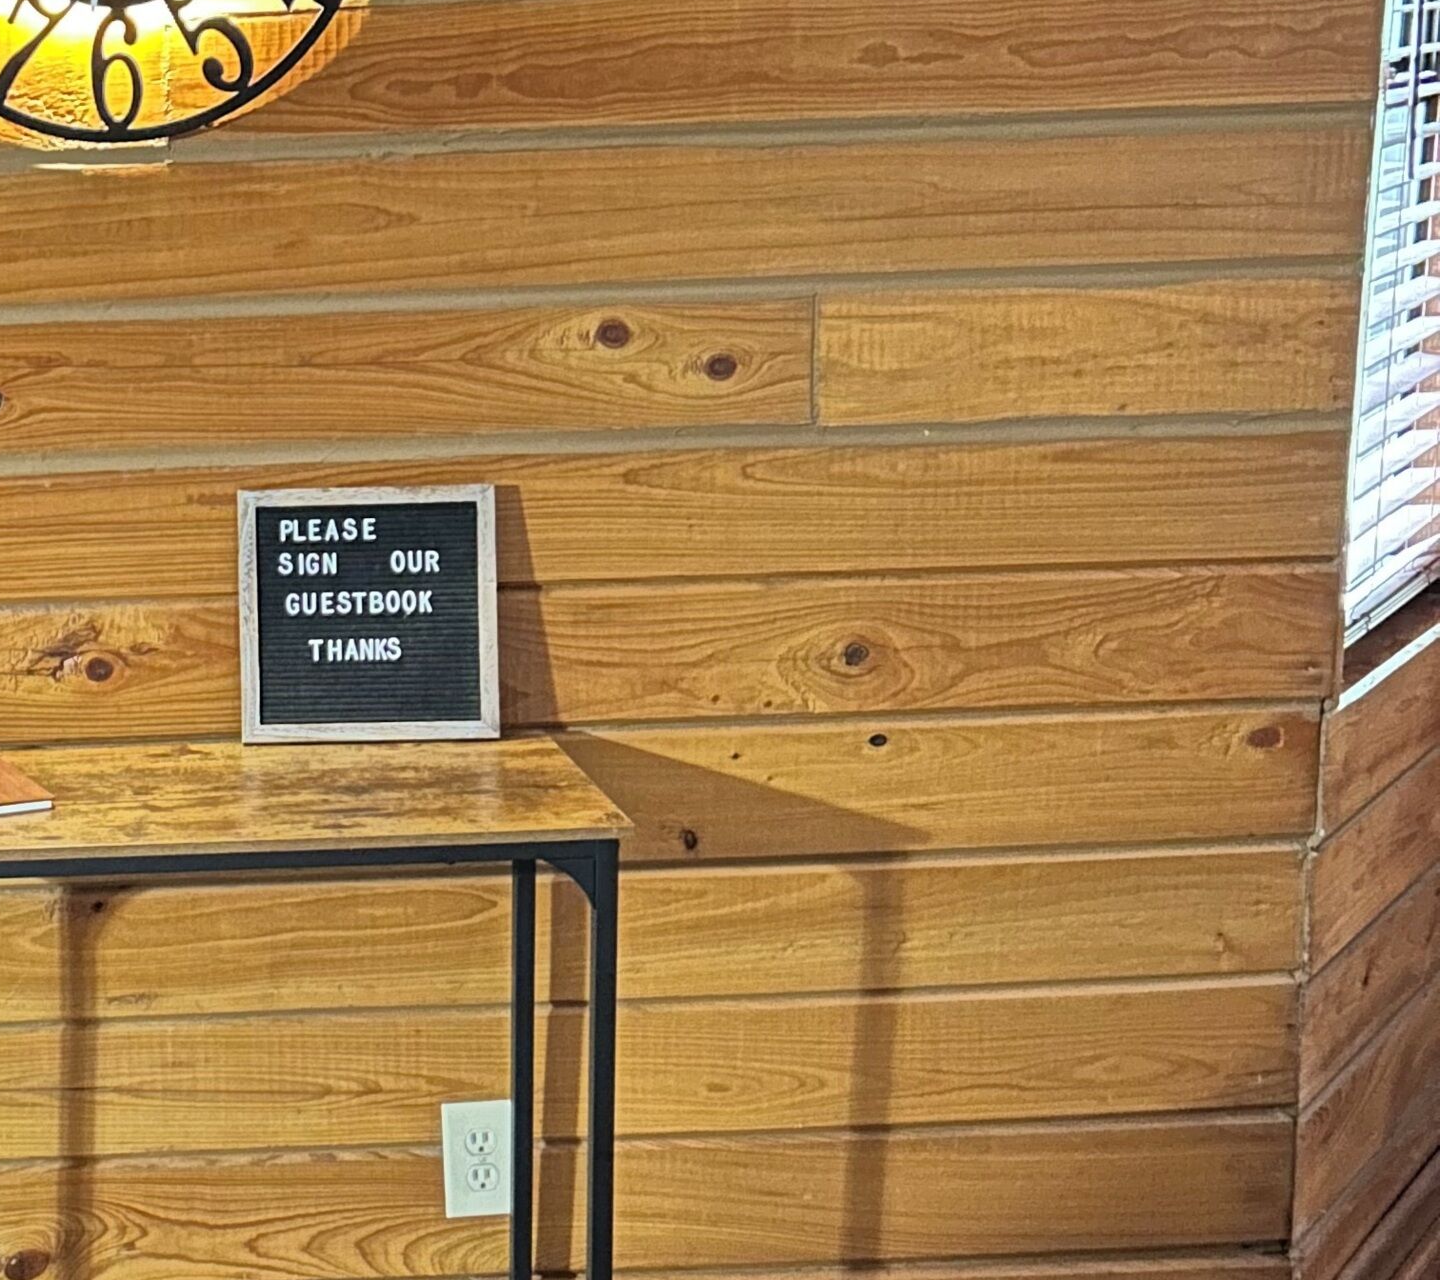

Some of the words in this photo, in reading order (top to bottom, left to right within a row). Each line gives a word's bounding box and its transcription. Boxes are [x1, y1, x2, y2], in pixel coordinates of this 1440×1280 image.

[91, 7, 143, 131] 6
[279, 517, 377, 543] PLEASE
[277, 552, 338, 575] SIGN
[389, 549, 440, 574] OUR
[285, 590, 433, 616] GUESTBOOK
[308, 637, 402, 662] THANKS
